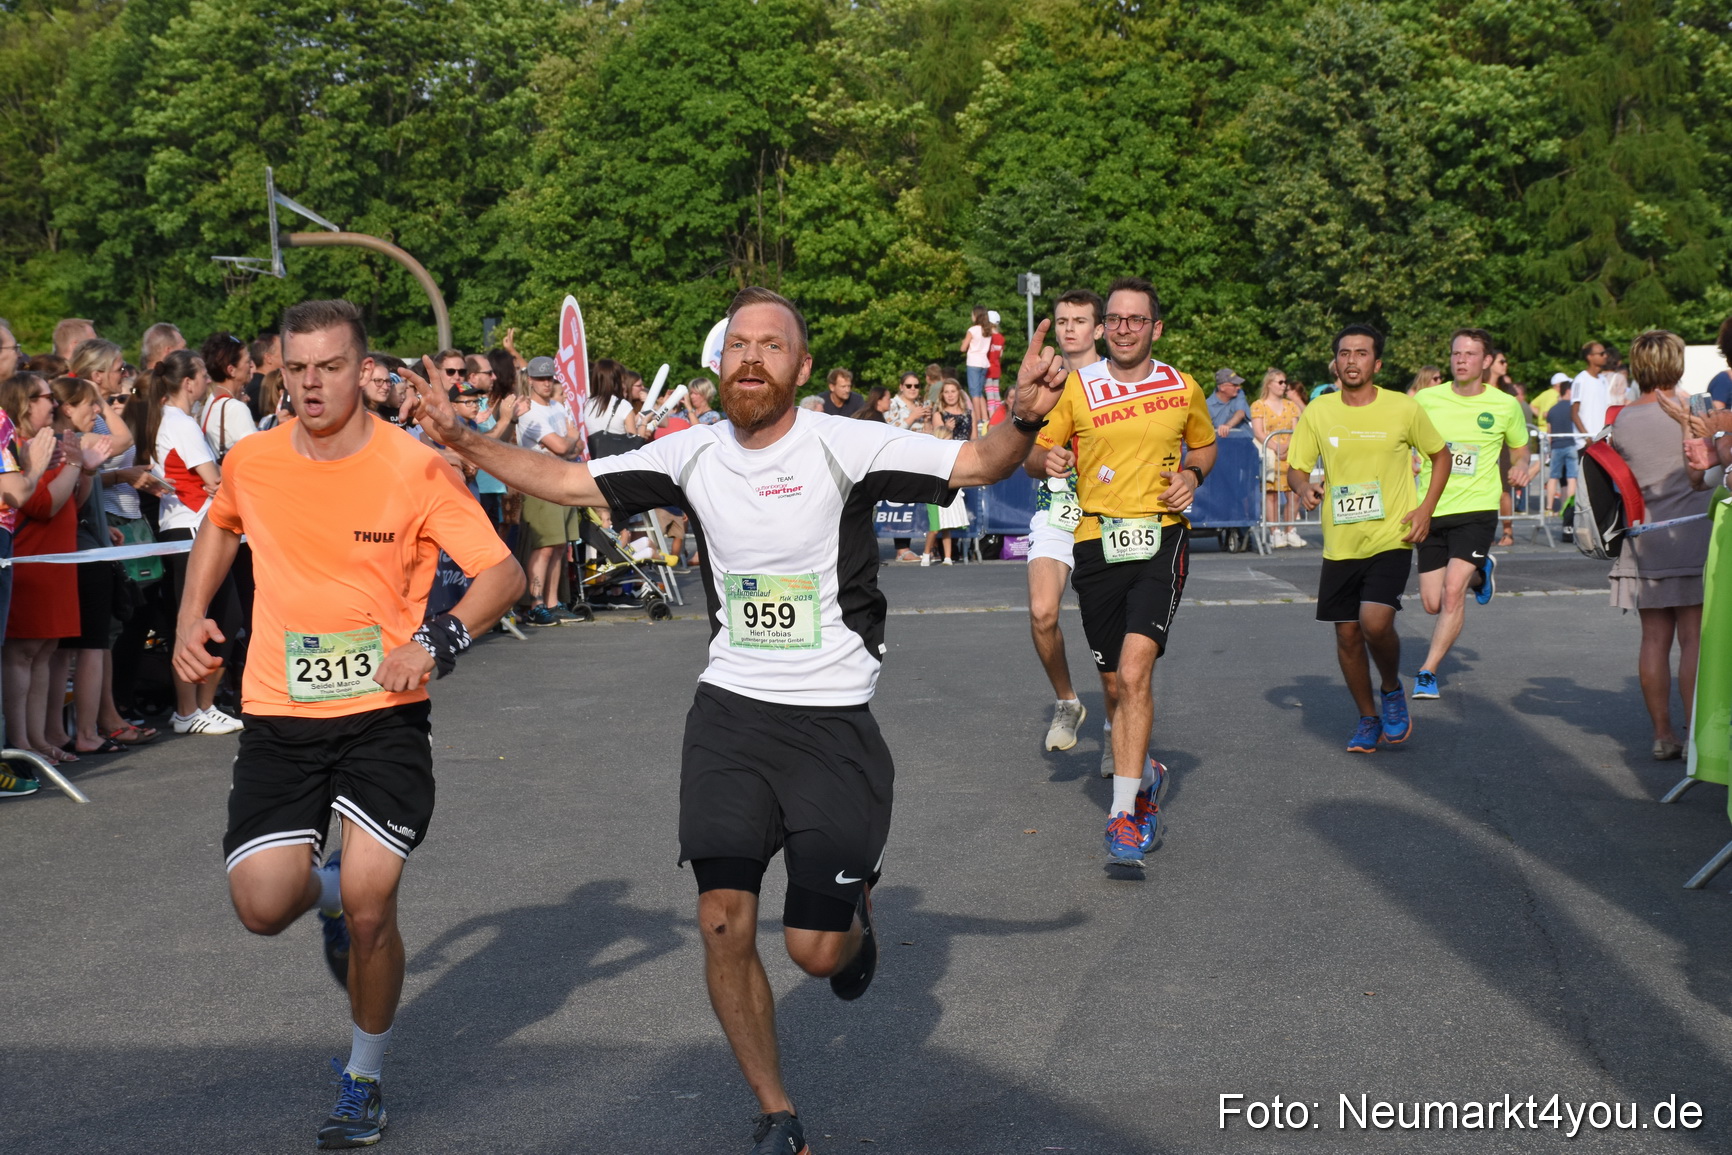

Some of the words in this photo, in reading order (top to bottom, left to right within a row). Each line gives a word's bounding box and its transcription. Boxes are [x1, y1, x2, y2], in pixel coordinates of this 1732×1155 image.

[1092, 405, 1138, 428] MAX
[1143, 395, 1189, 415] BÖGL
[765, 485, 803, 497] partner
[1337, 495, 1375, 512] 1277
[354, 531, 395, 543] THULE
[1109, 529, 1155, 549] 1685
[794, 594, 813, 602] 2019
[743, 601, 796, 629] 959
[767, 630, 792, 638] Tobias
[296, 653, 372, 682] 2313
[311, 682, 335, 690] Seidel
[336, 680, 361, 688] Marco
